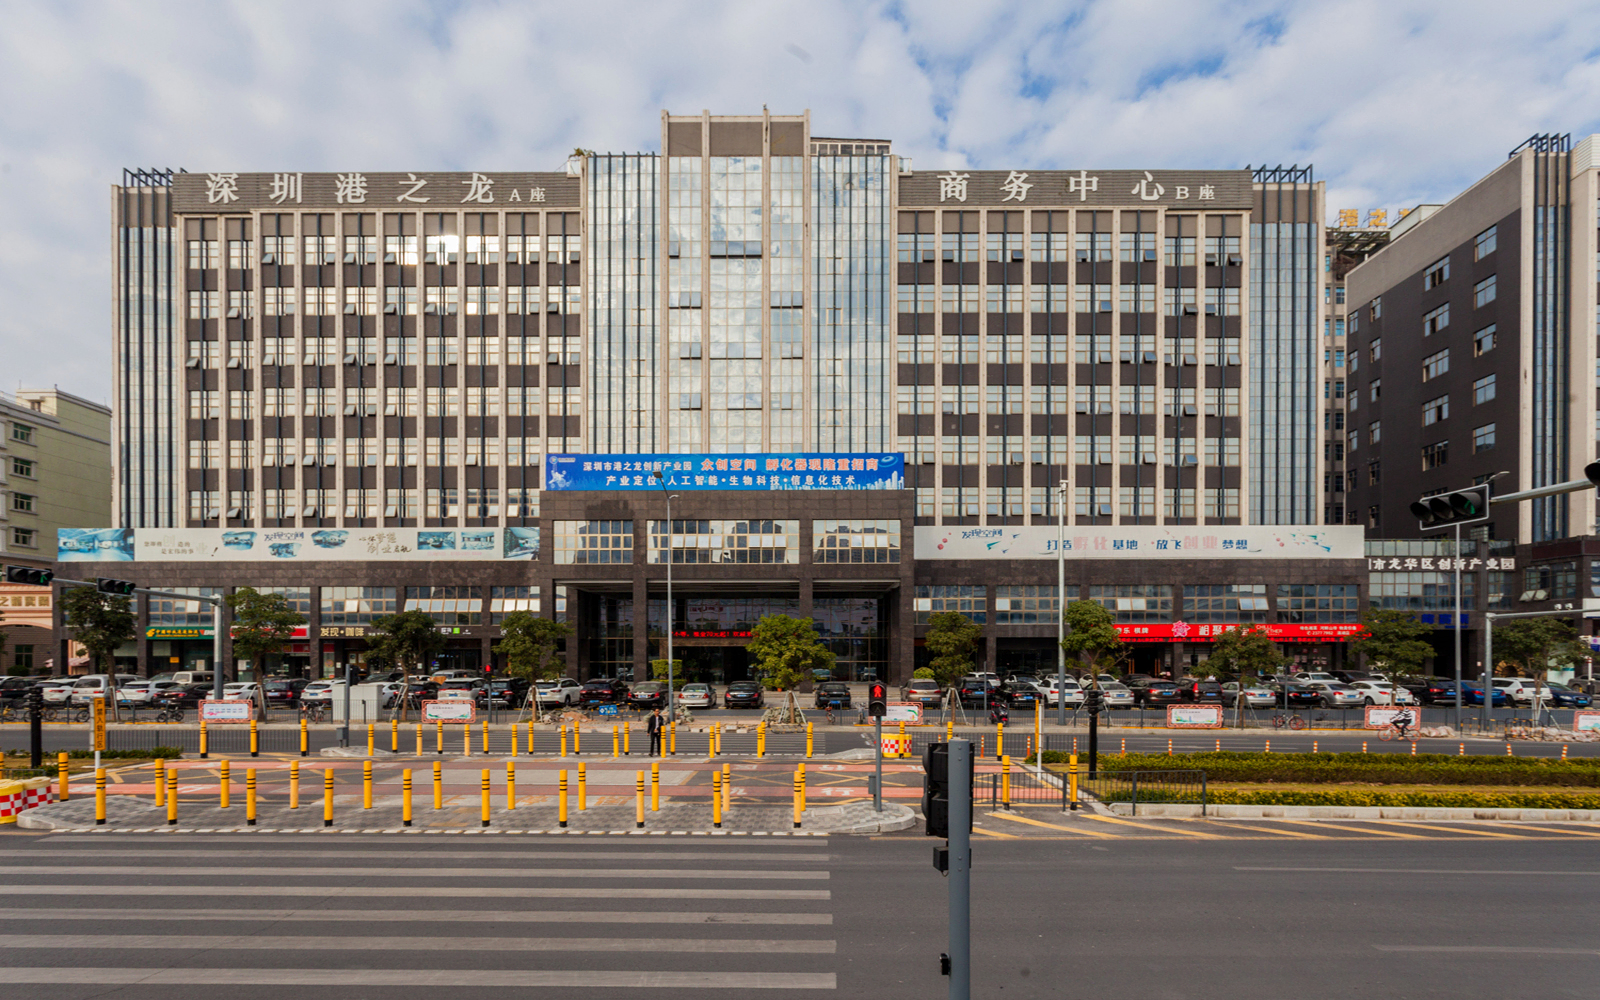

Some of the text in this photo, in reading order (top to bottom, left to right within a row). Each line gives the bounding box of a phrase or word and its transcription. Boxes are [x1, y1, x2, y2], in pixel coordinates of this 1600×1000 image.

[205, 172, 495, 204] 深圳港之龙
[937, 170, 1165, 203] 商务中心
[583, 458, 879, 472] 深圳市港之龙创新产业园 众创空间 孵化器现隆重招商
[1368, 558, 1516, 570] 市龙华区创新产业园
